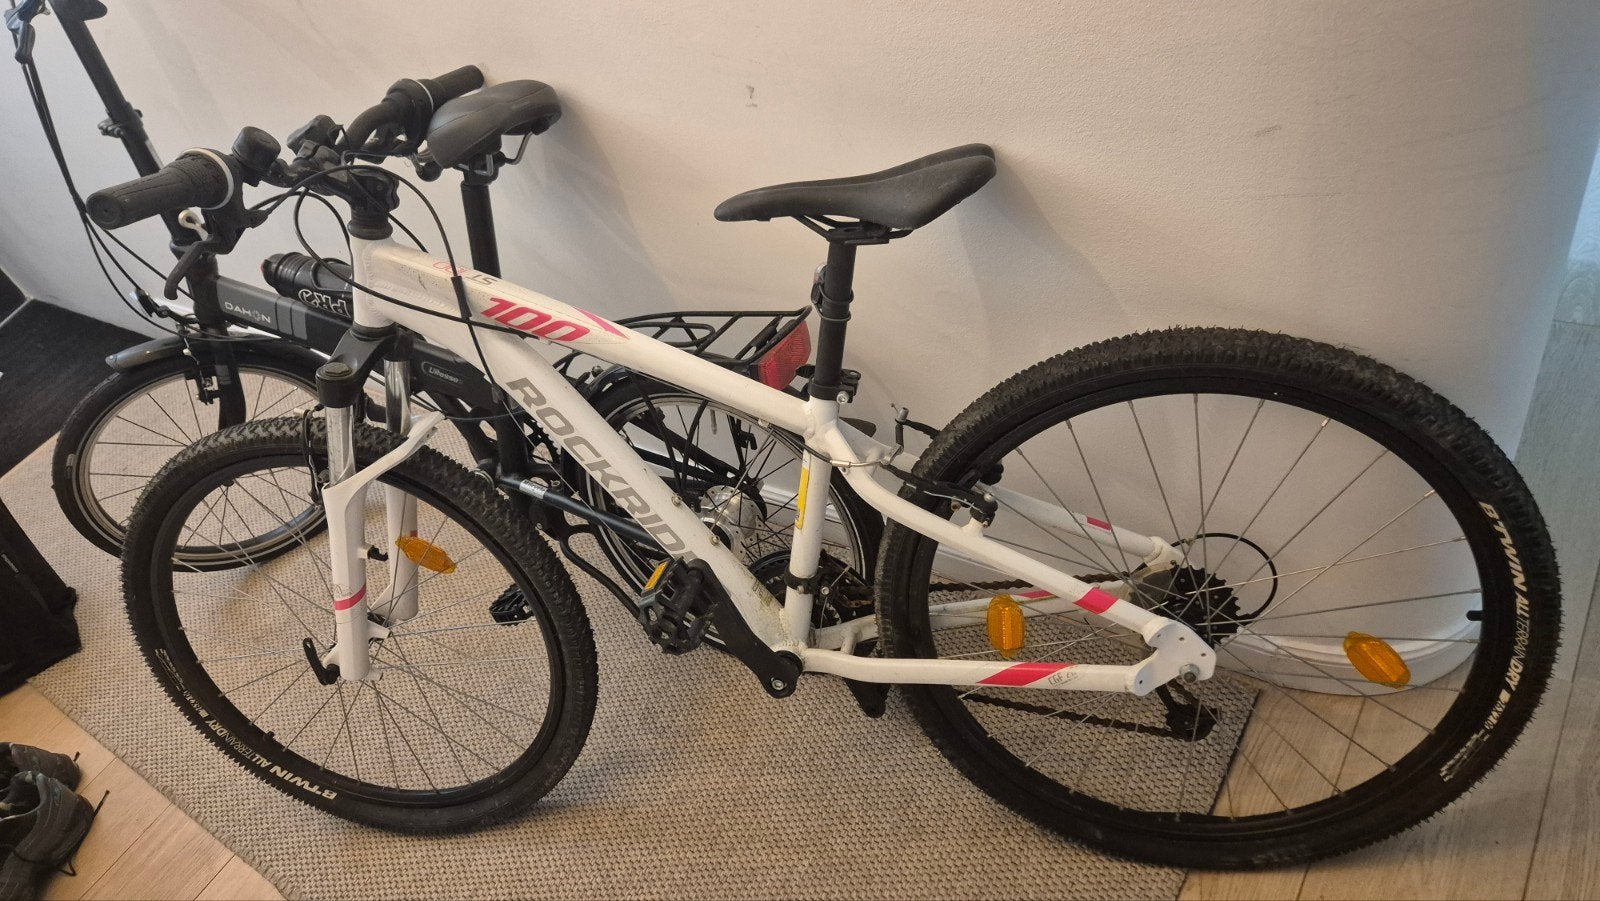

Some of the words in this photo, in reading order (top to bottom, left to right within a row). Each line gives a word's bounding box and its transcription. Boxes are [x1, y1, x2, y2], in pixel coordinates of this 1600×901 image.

[466, 274, 498, 286] ST
[224, 301, 271, 324] DAHON
[481, 297, 590, 342] 100
